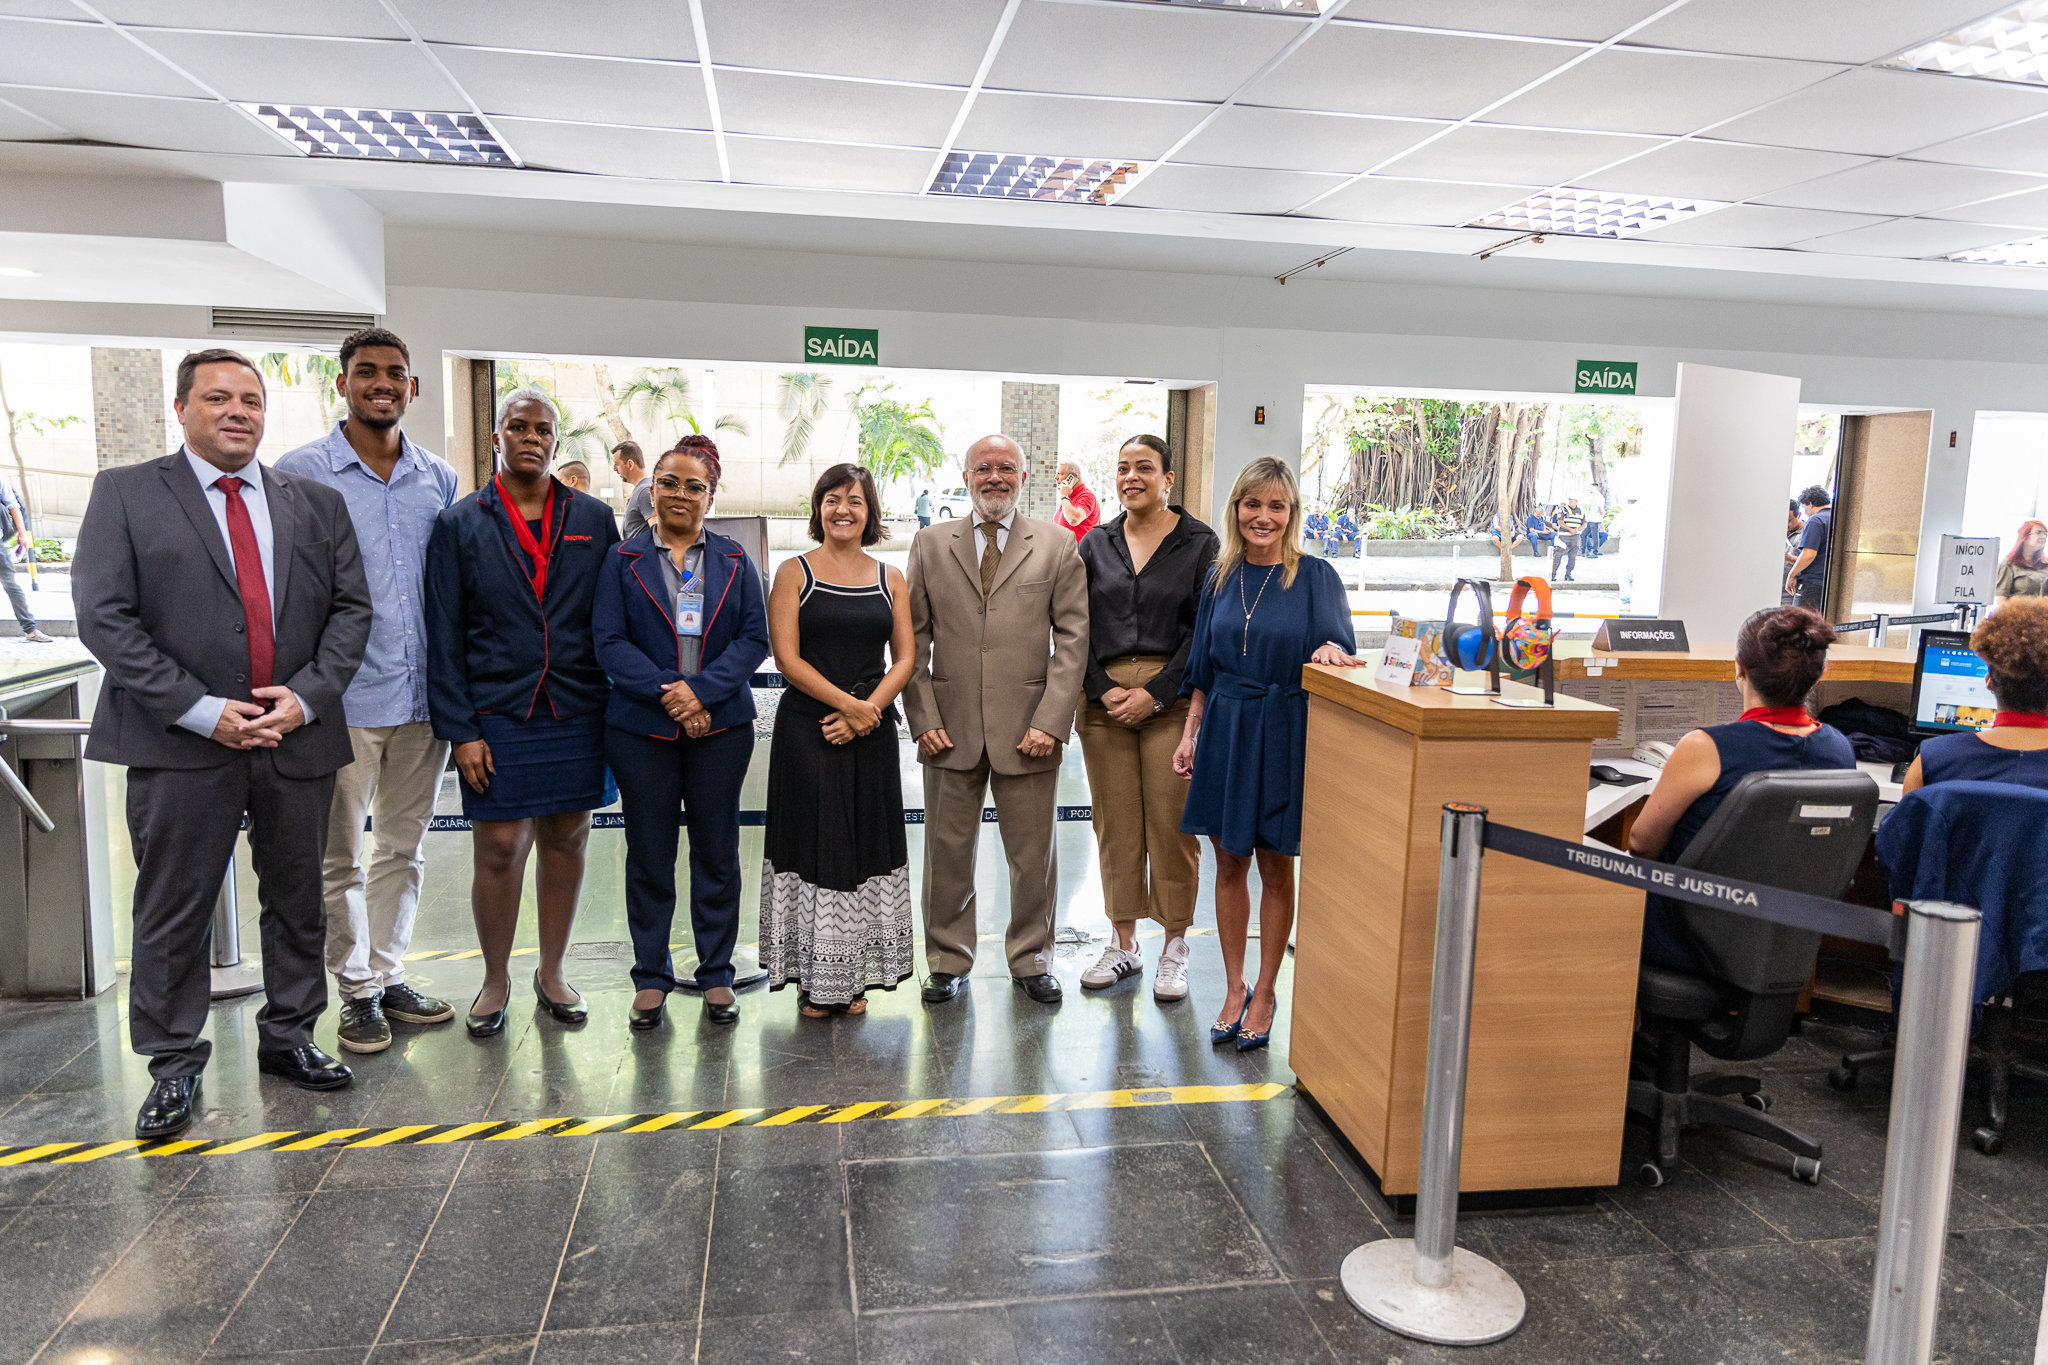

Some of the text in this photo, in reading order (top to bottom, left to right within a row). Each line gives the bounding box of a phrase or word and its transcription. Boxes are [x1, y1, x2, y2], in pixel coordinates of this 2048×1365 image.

[807, 334, 876, 359] SAÍDA
[1577, 366, 1635, 389] SAÍDA
[1955, 542, 1985, 556] INÍCIO
[1960, 565, 1975, 576] DA
[1954, 586, 1975, 598] FILA
[1619, 629, 1676, 642] INFORMAÇÕES
[1566, 848, 1760, 907] TRIBUNAL DE JUSTIÇA
